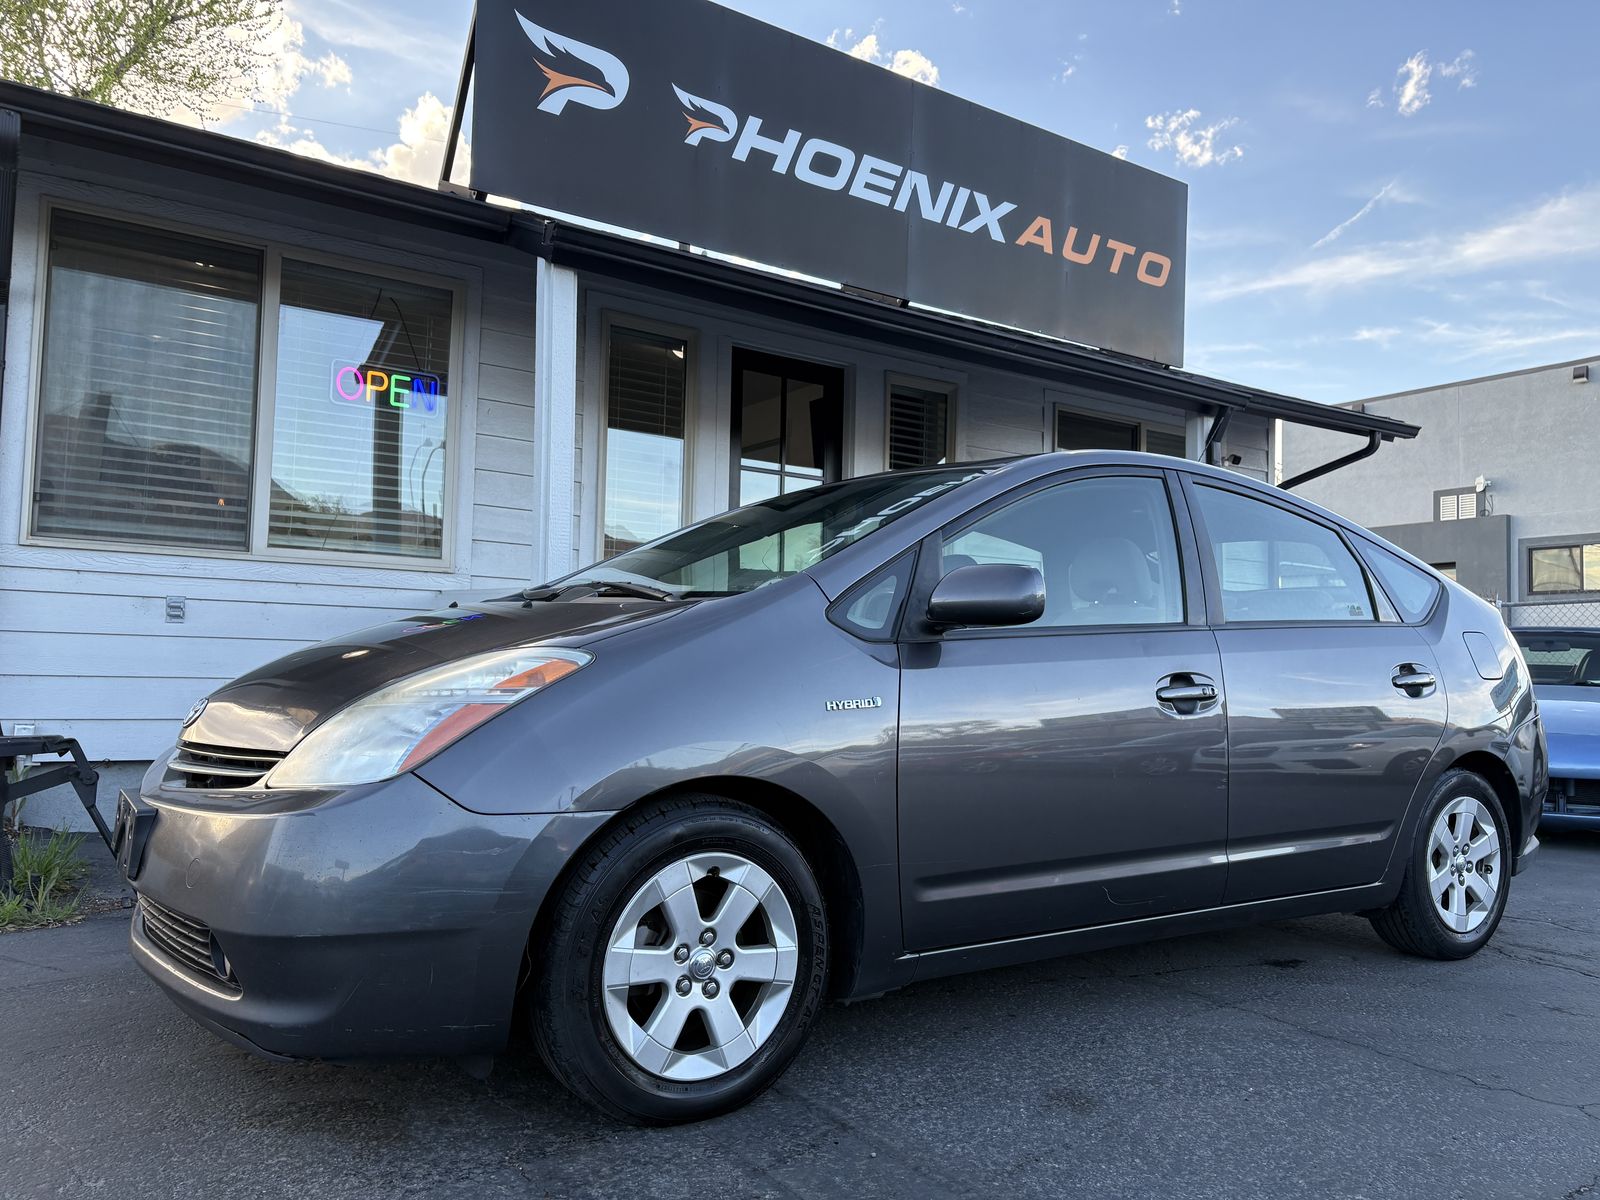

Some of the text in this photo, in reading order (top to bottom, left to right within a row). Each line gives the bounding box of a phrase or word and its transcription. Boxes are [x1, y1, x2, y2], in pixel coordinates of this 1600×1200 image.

[671, 82, 1171, 288] PHOENIX AUTO
[336, 366, 436, 412] OPEN
[825, 698, 875, 711] HYBRID
[808, 903, 826, 971] ASPEN
